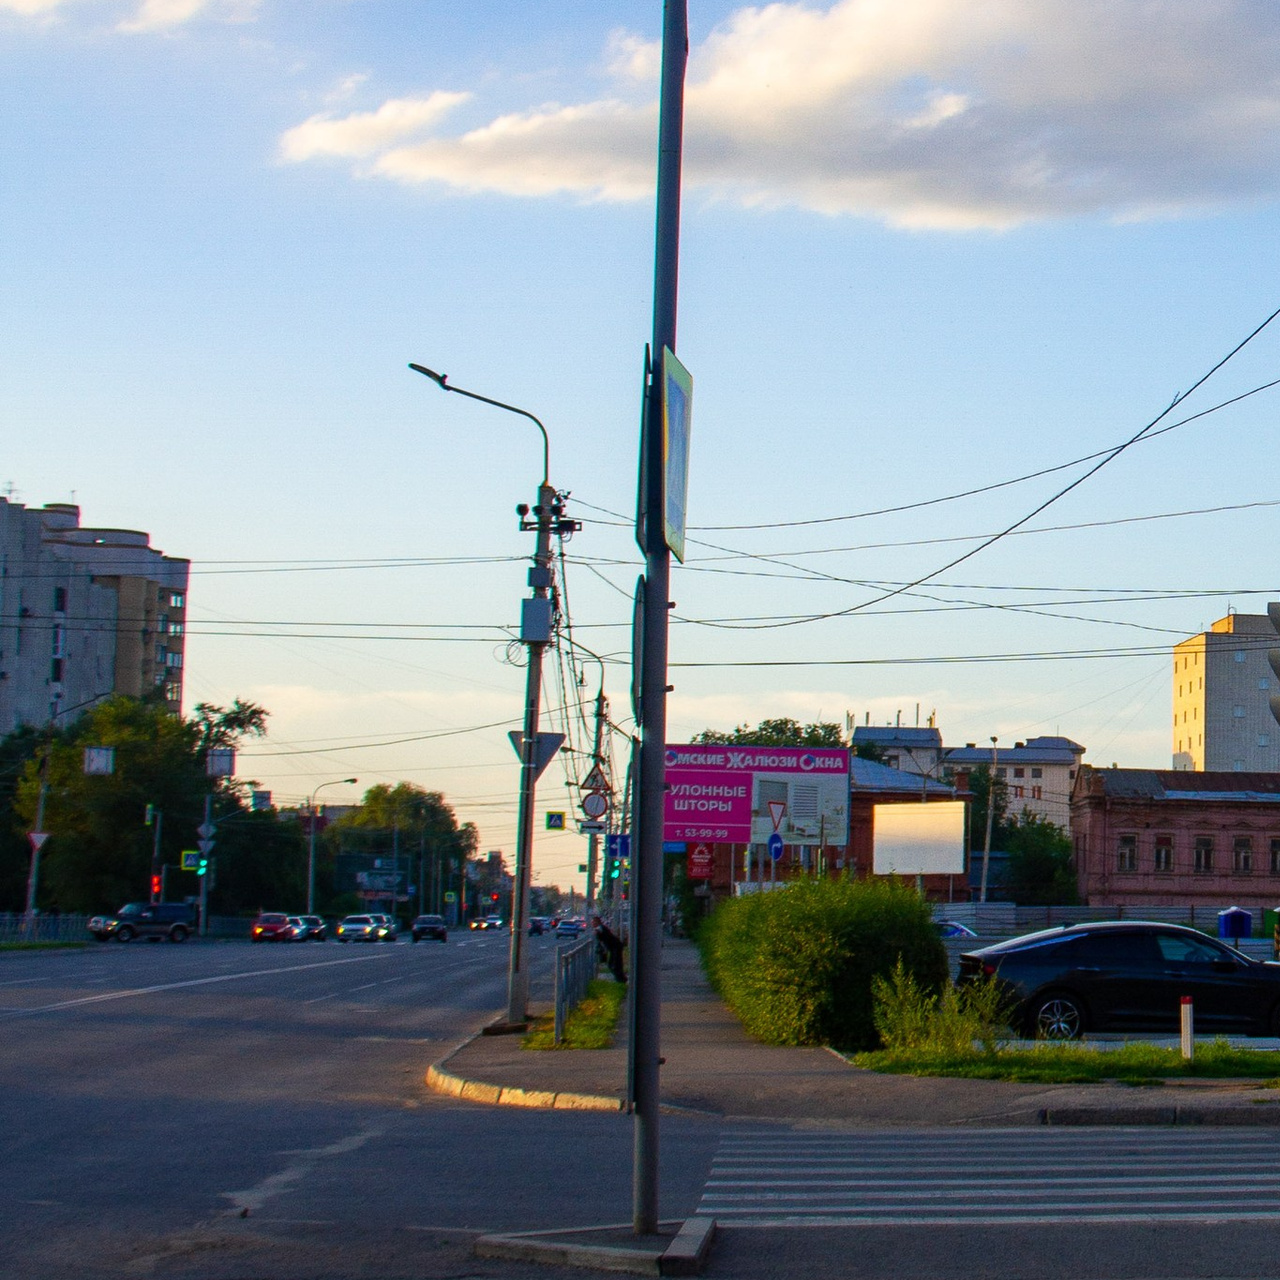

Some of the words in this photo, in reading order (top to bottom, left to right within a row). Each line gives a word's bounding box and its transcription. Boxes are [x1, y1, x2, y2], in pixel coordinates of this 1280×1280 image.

[664, 749, 725, 767] ОМСКИЕ
[726, 751, 797, 769] ЖАЛЮЗИ
[799, 753, 844, 771] ОКНА
[666, 784, 747, 798] УЛОННЫЕ
[674, 799, 733, 813] ШТОРЫ
[685, 827, 729, 838] 53-99-99
